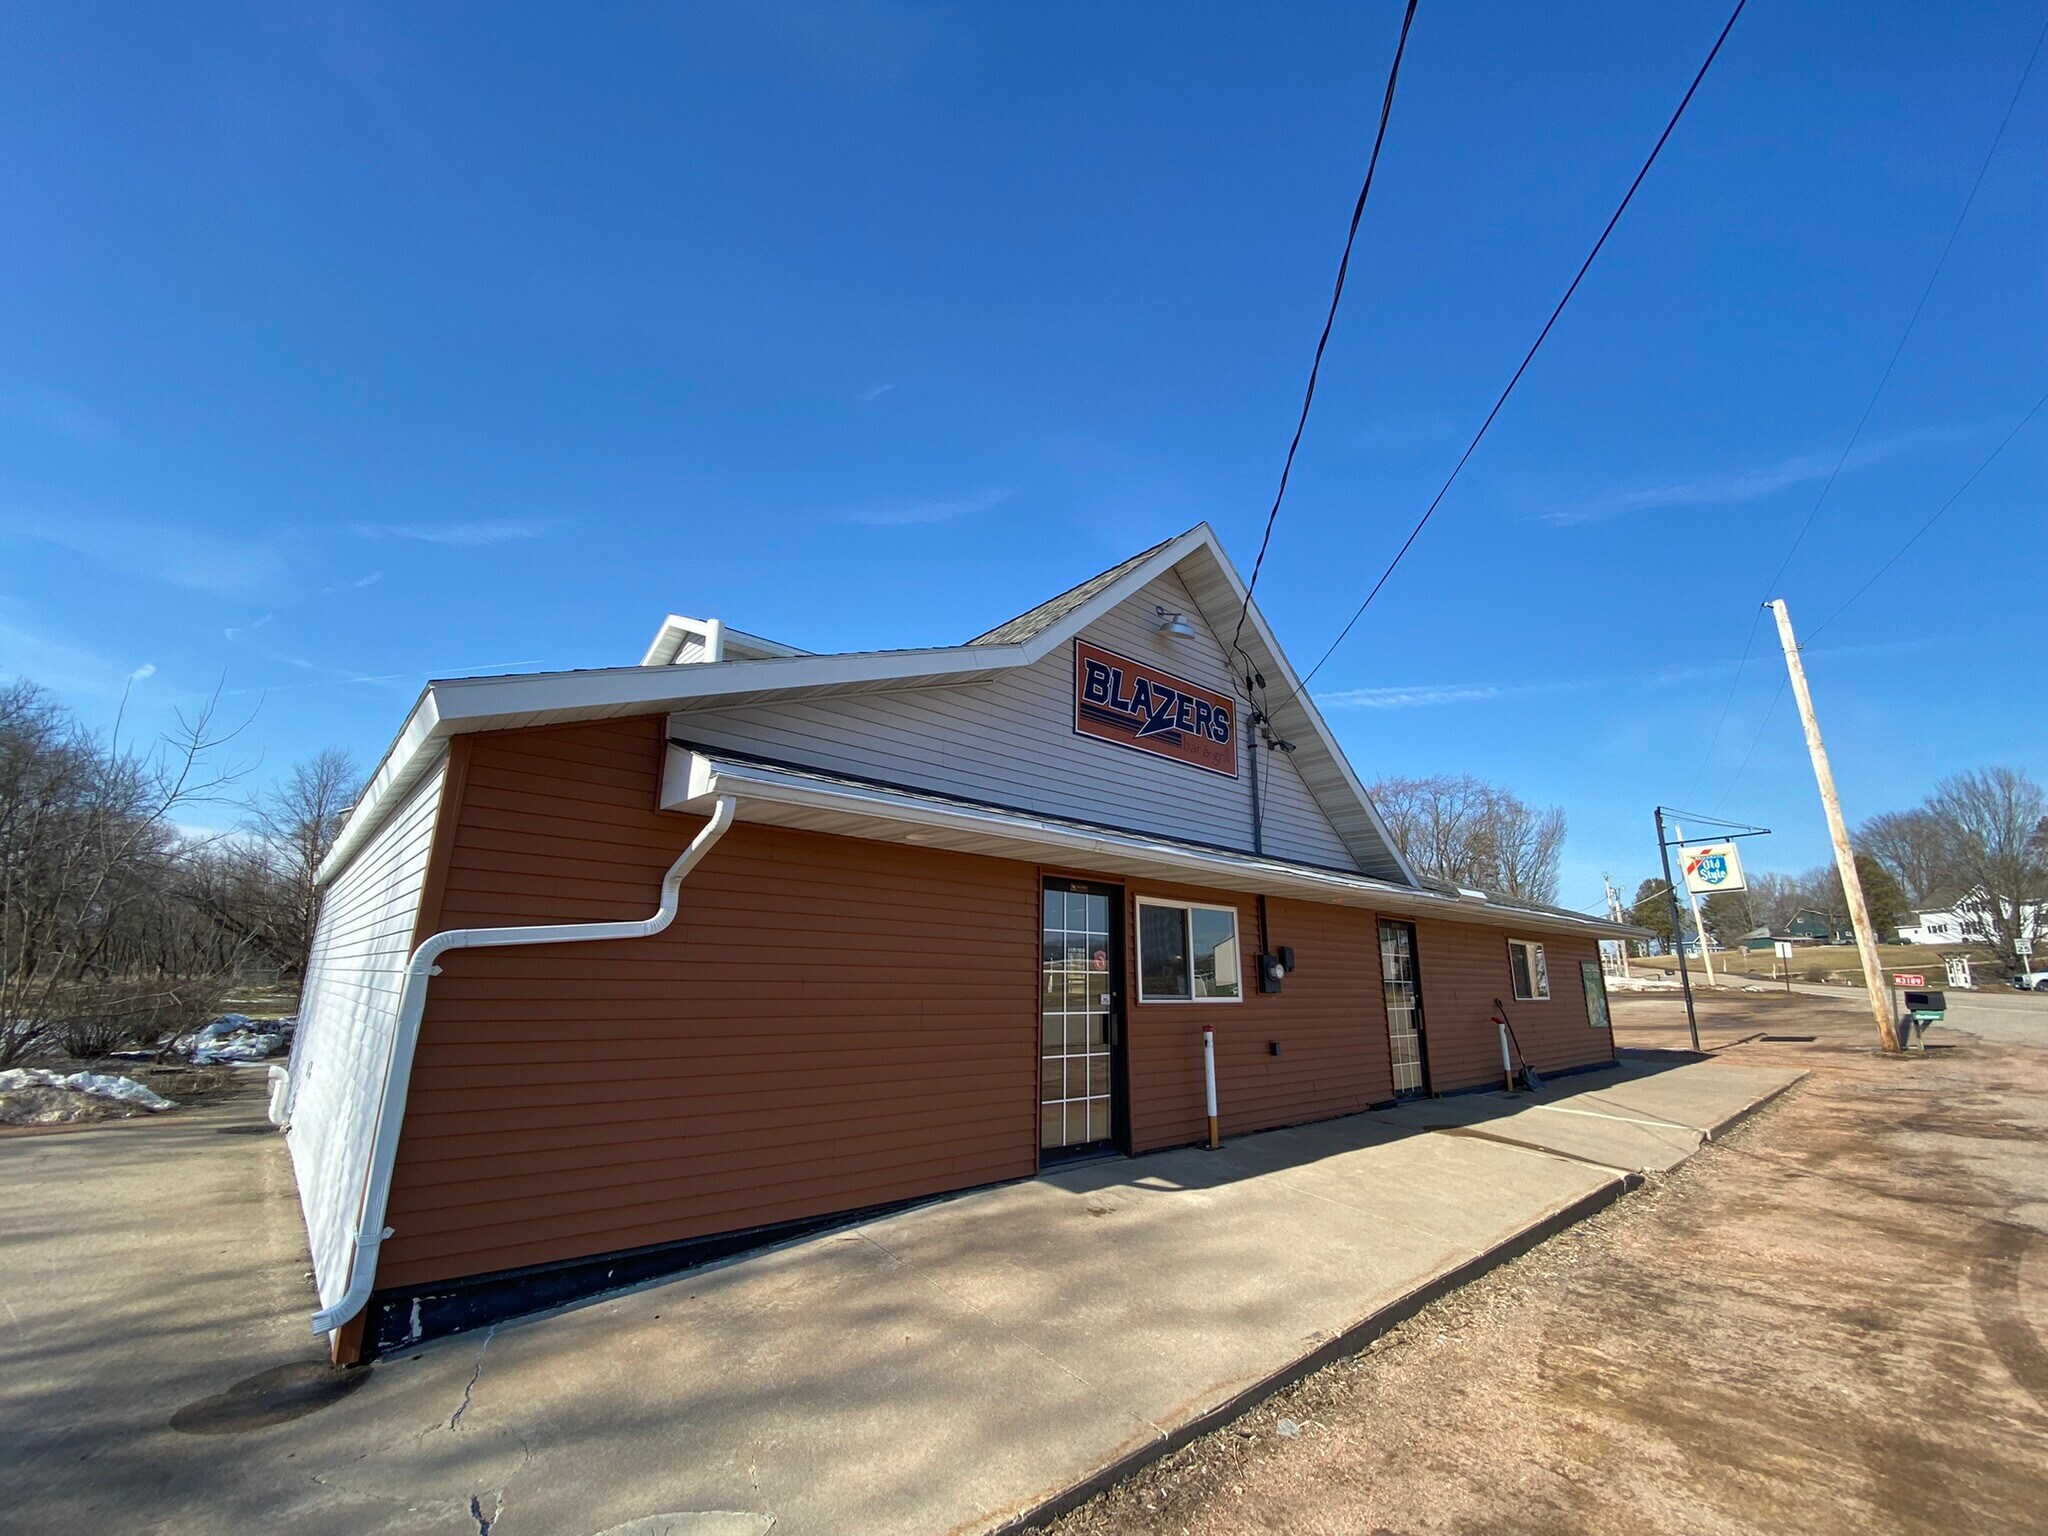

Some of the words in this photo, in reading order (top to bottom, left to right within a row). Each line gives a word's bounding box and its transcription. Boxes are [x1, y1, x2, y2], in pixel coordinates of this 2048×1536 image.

[1083, 657, 1230, 745] BLAZERS
[1183, 734, 1201, 754] bar
[1203, 745, 1212, 758] &
[1213, 746, 1231, 767] grill
[1700, 868, 1726, 882] Style
[1703, 858, 1720, 869] Old
